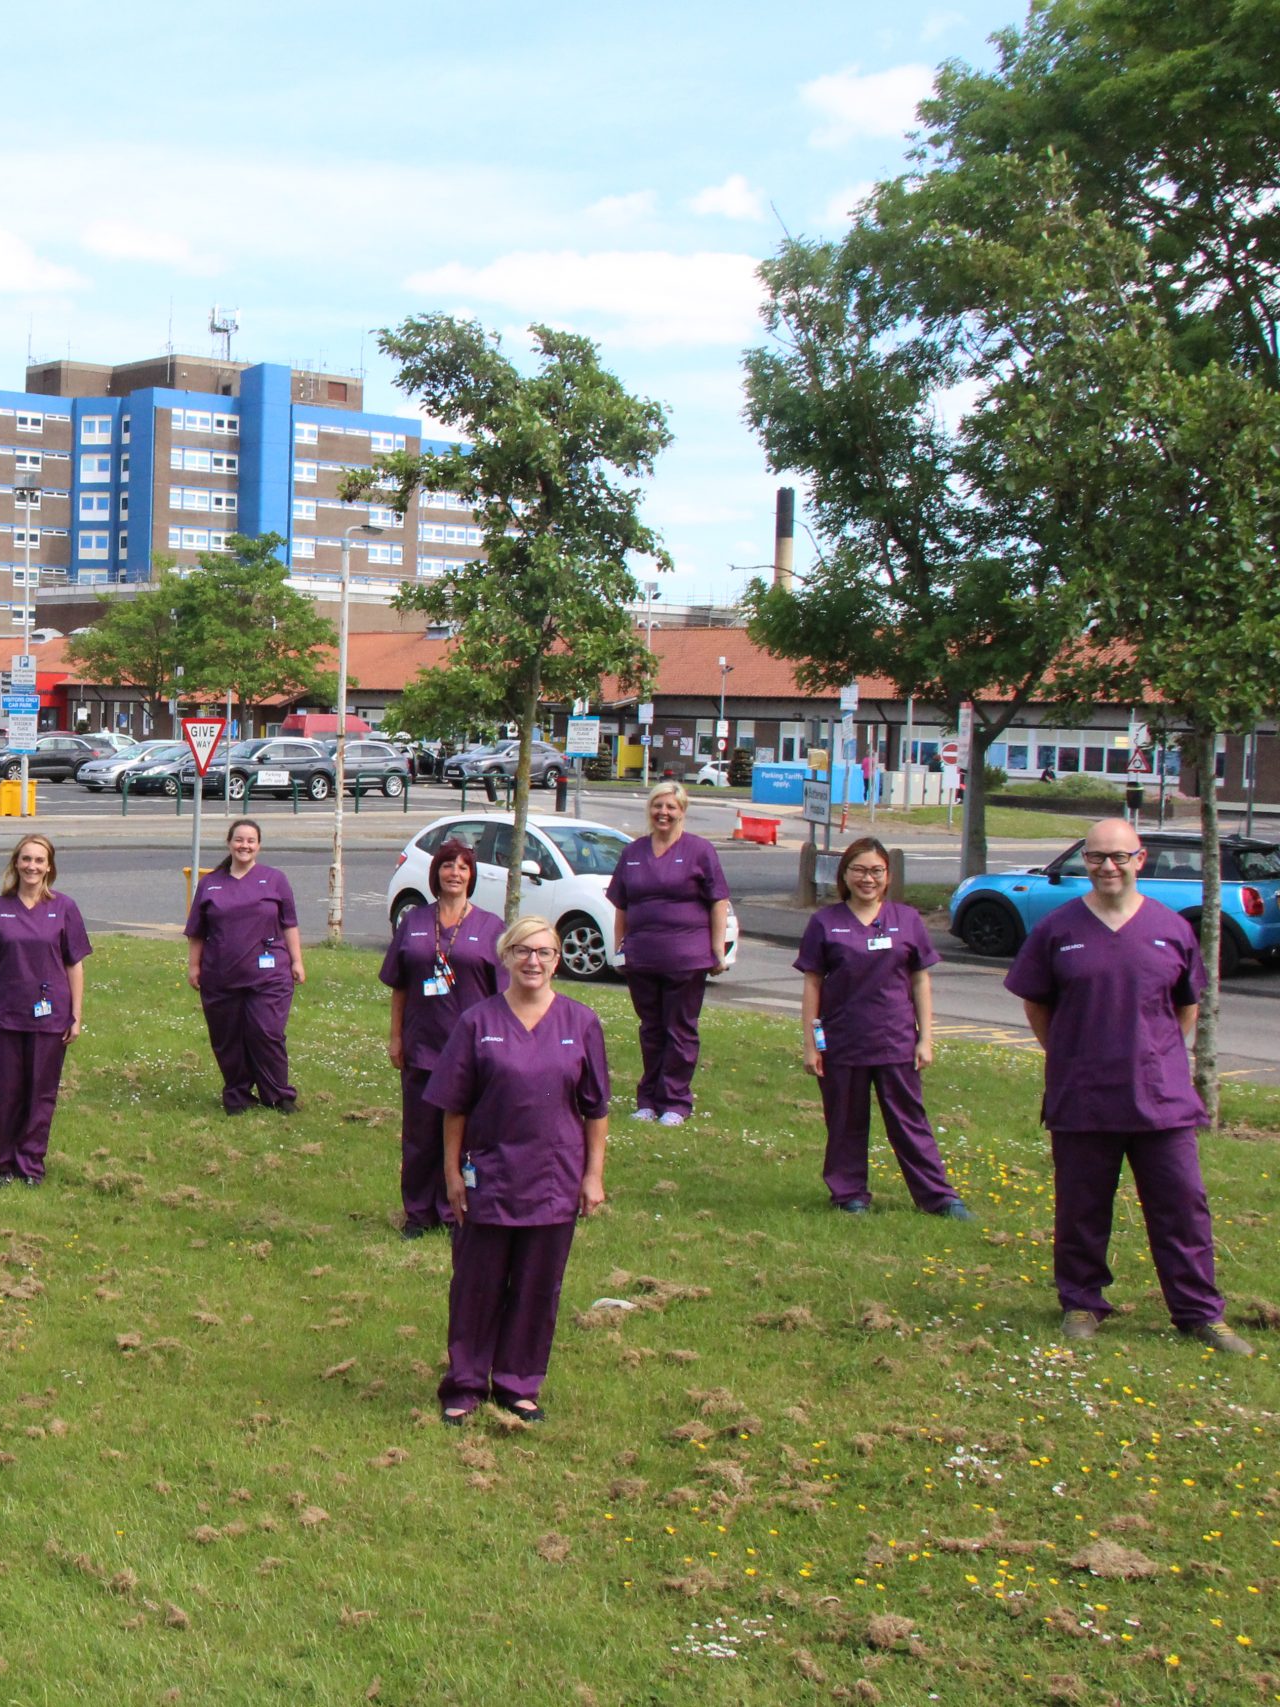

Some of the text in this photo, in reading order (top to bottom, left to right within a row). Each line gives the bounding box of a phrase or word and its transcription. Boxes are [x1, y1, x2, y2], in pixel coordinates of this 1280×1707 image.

[191, 726, 215, 737] GIVE
[762, 772, 804, 780] Parking Tariffs
